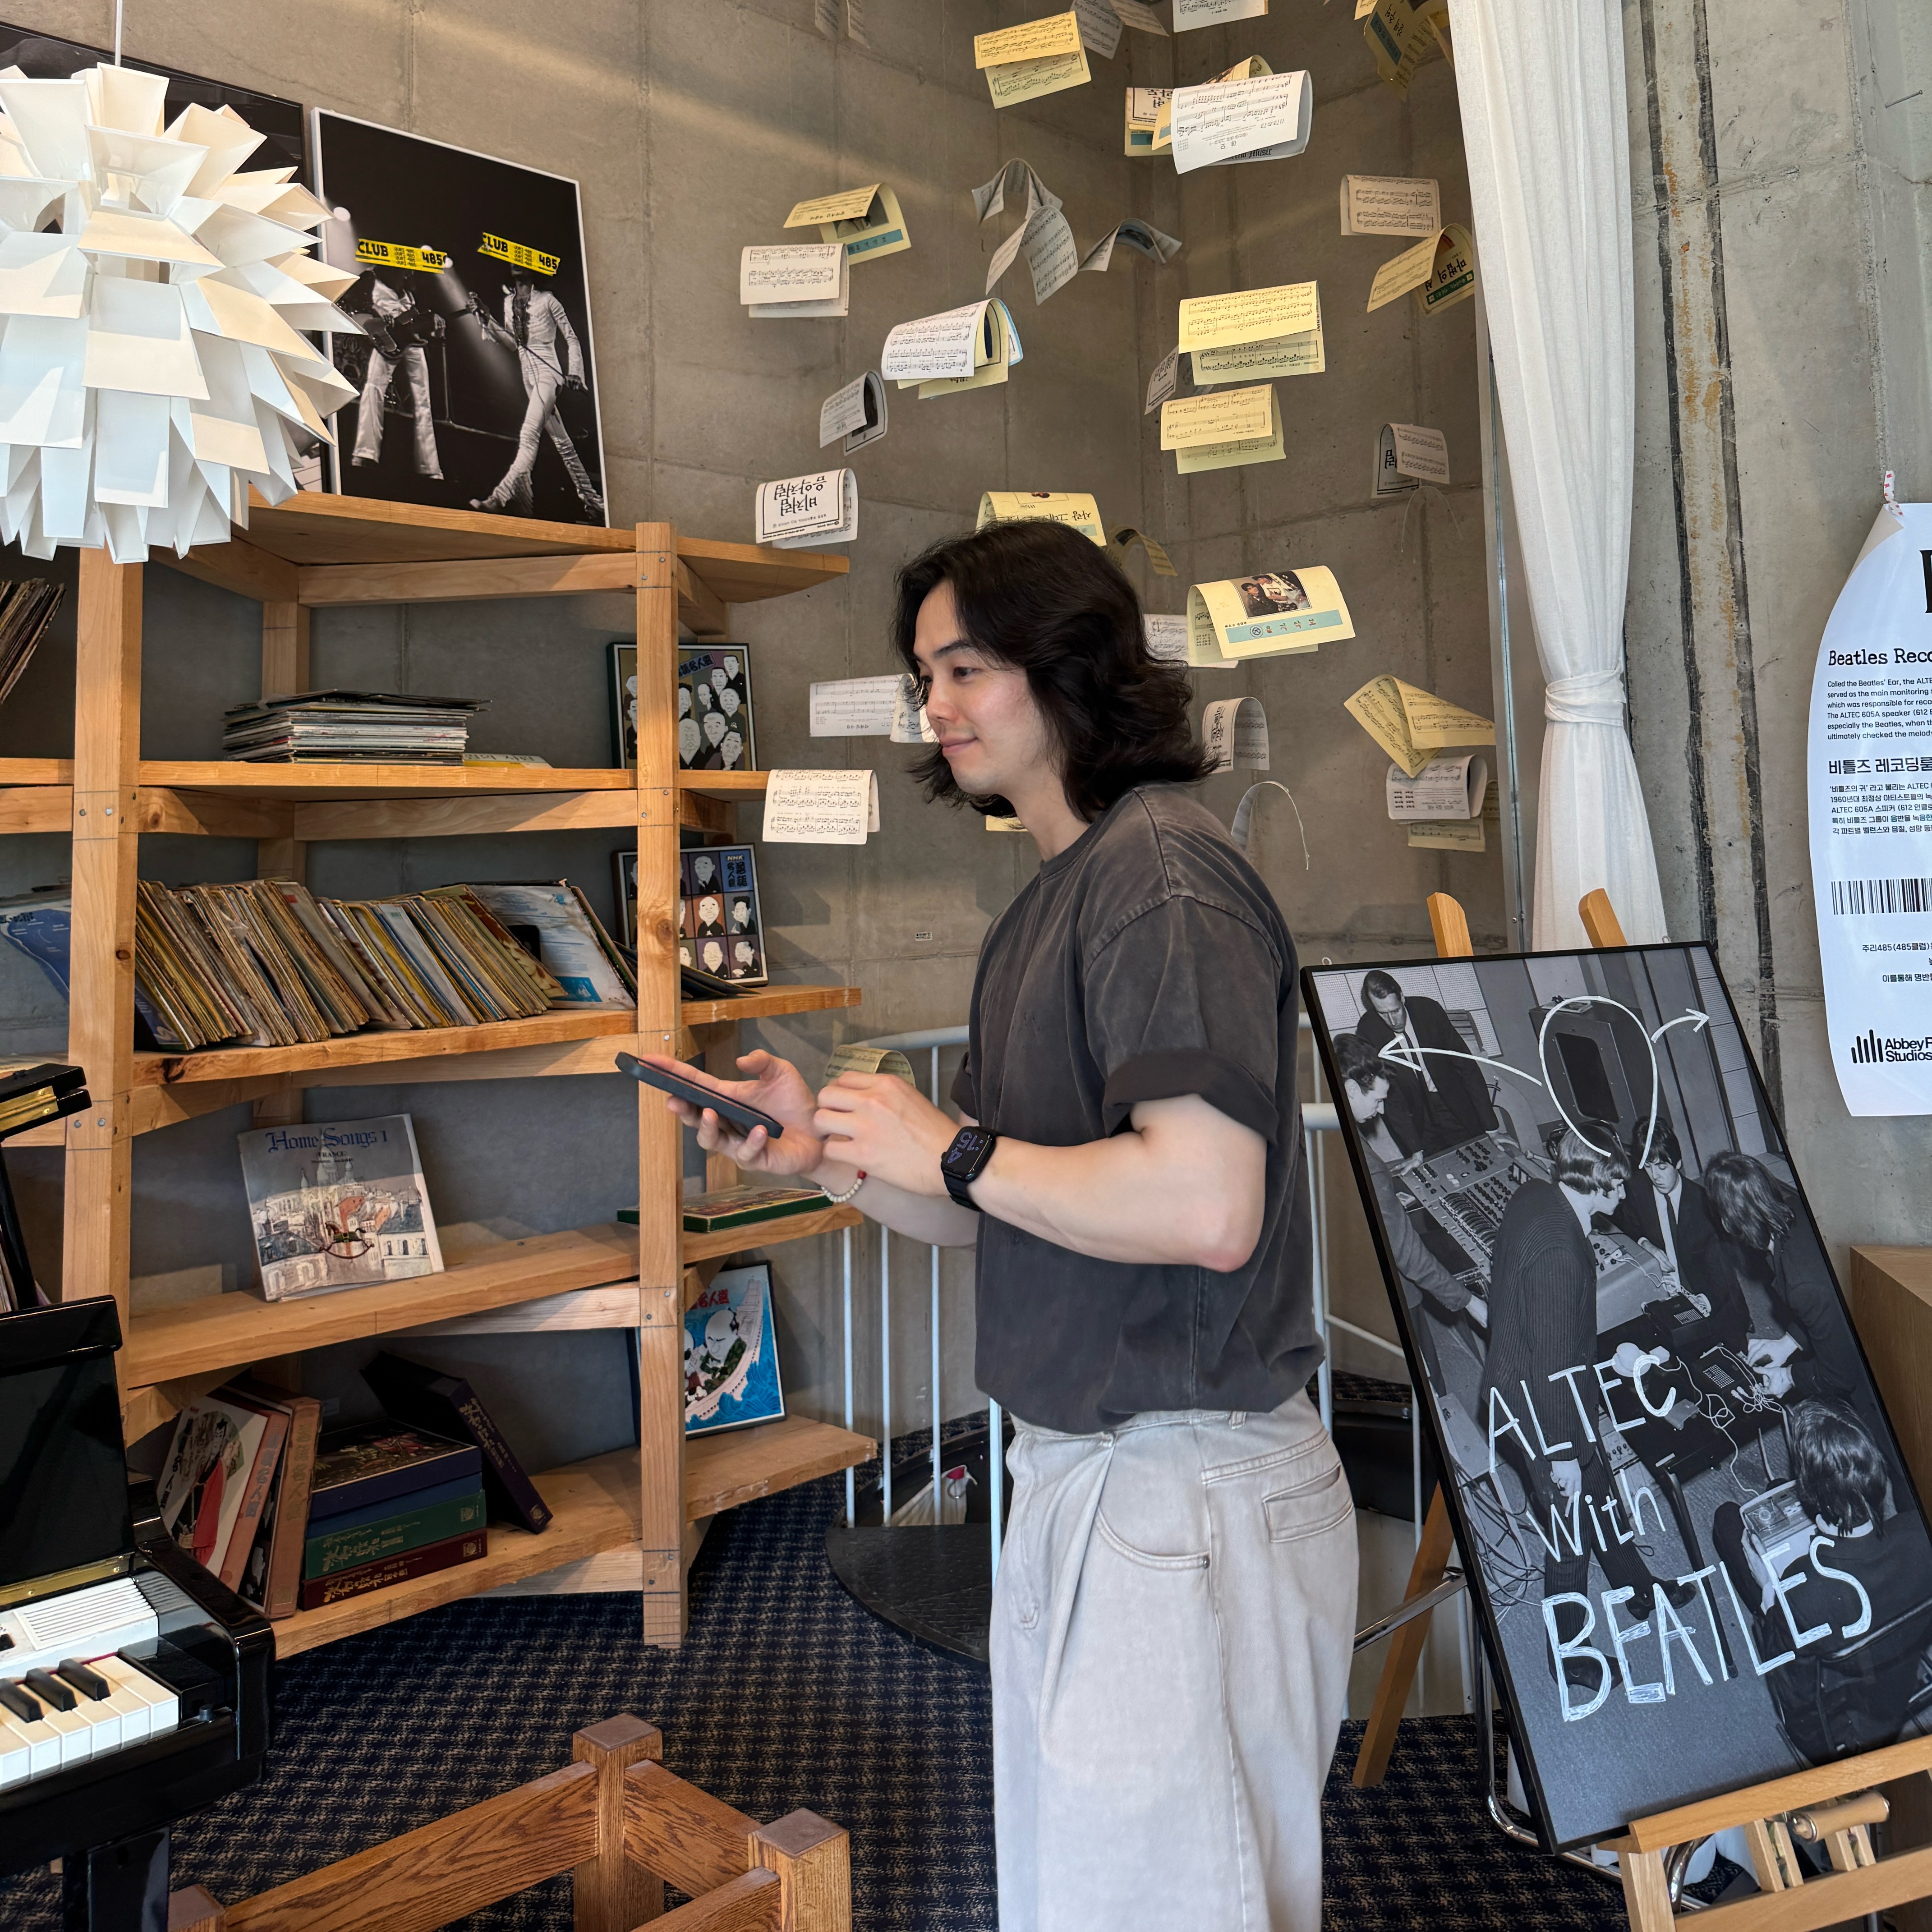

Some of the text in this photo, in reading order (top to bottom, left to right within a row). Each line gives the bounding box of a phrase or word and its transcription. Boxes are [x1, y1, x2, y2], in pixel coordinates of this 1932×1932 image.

[358, 241, 388, 257] CLUB
[422, 252, 442, 265] 485
[538, 253, 557, 270] 485
[774, 475, 827, 500] 음악처럼
[781, 495, 817, 516] 비처럼
[1072, 510, 1091, 520] 사랑
[1828, 649, 1888, 666] Beatles
[1890, 689, 1929, 697] monitoring
[1881, 710, 1911, 718] speaker
[1827, 722, 1860, 731] especially
[1828, 732, 1861, 741] ultimately
[1829, 757, 1932, 774] 비틀즈 레코딩룸
[1862, 942, 1932, 952] 주리485(485클럽)
[1882, 974, 1912, 982] 이를통해
[1885, 1038, 1924, 1051] Abbey
[1886, 1050, 1932, 1062] Studios
[266, 1130, 318, 1153] Home
[322, 1127, 377, 1148] Songs
[1488, 1354, 1677, 1474] ALTEC
[1541, 1536, 1873, 1723] BEATLES
